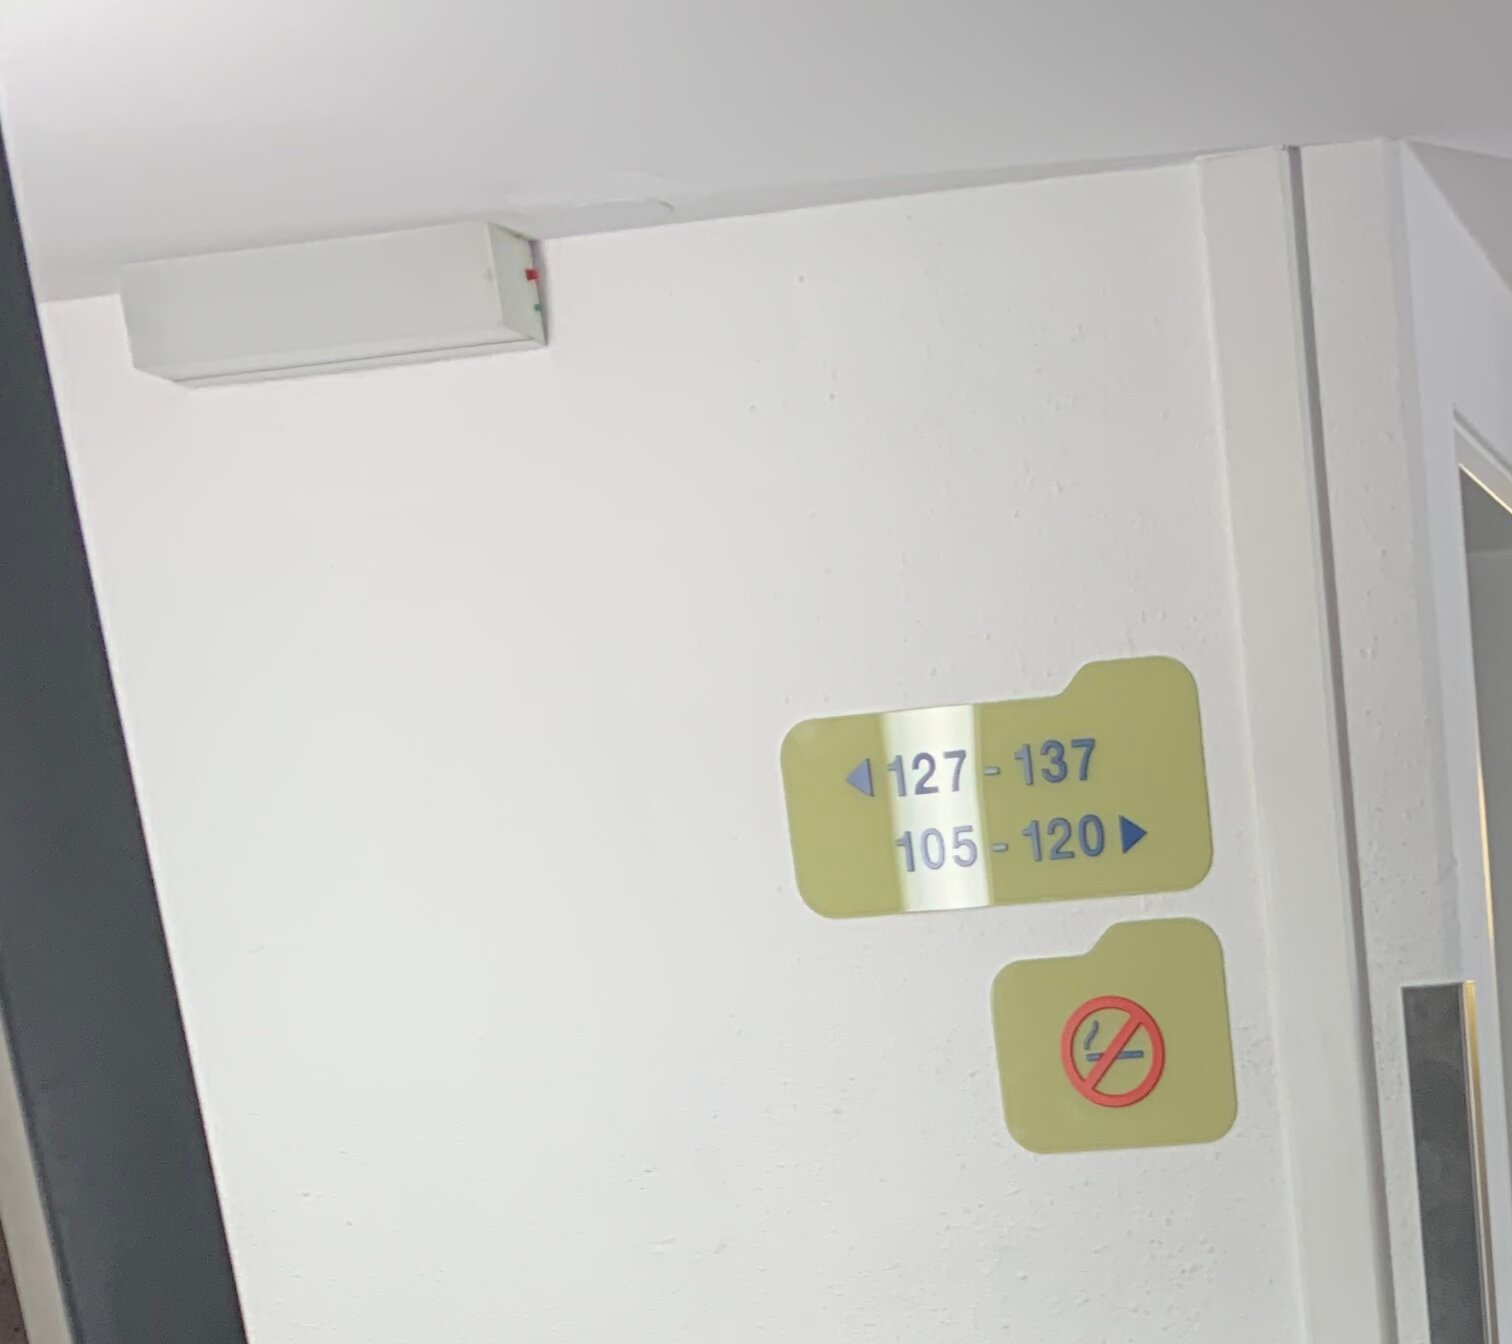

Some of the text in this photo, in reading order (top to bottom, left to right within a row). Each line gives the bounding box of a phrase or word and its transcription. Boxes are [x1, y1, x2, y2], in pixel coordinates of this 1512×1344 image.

[887, 749, 967, 798] 127
[1013, 738, 1096, 786] 137
[896, 825, 978, 872] 105
[1022, 814, 1106, 862] 120
